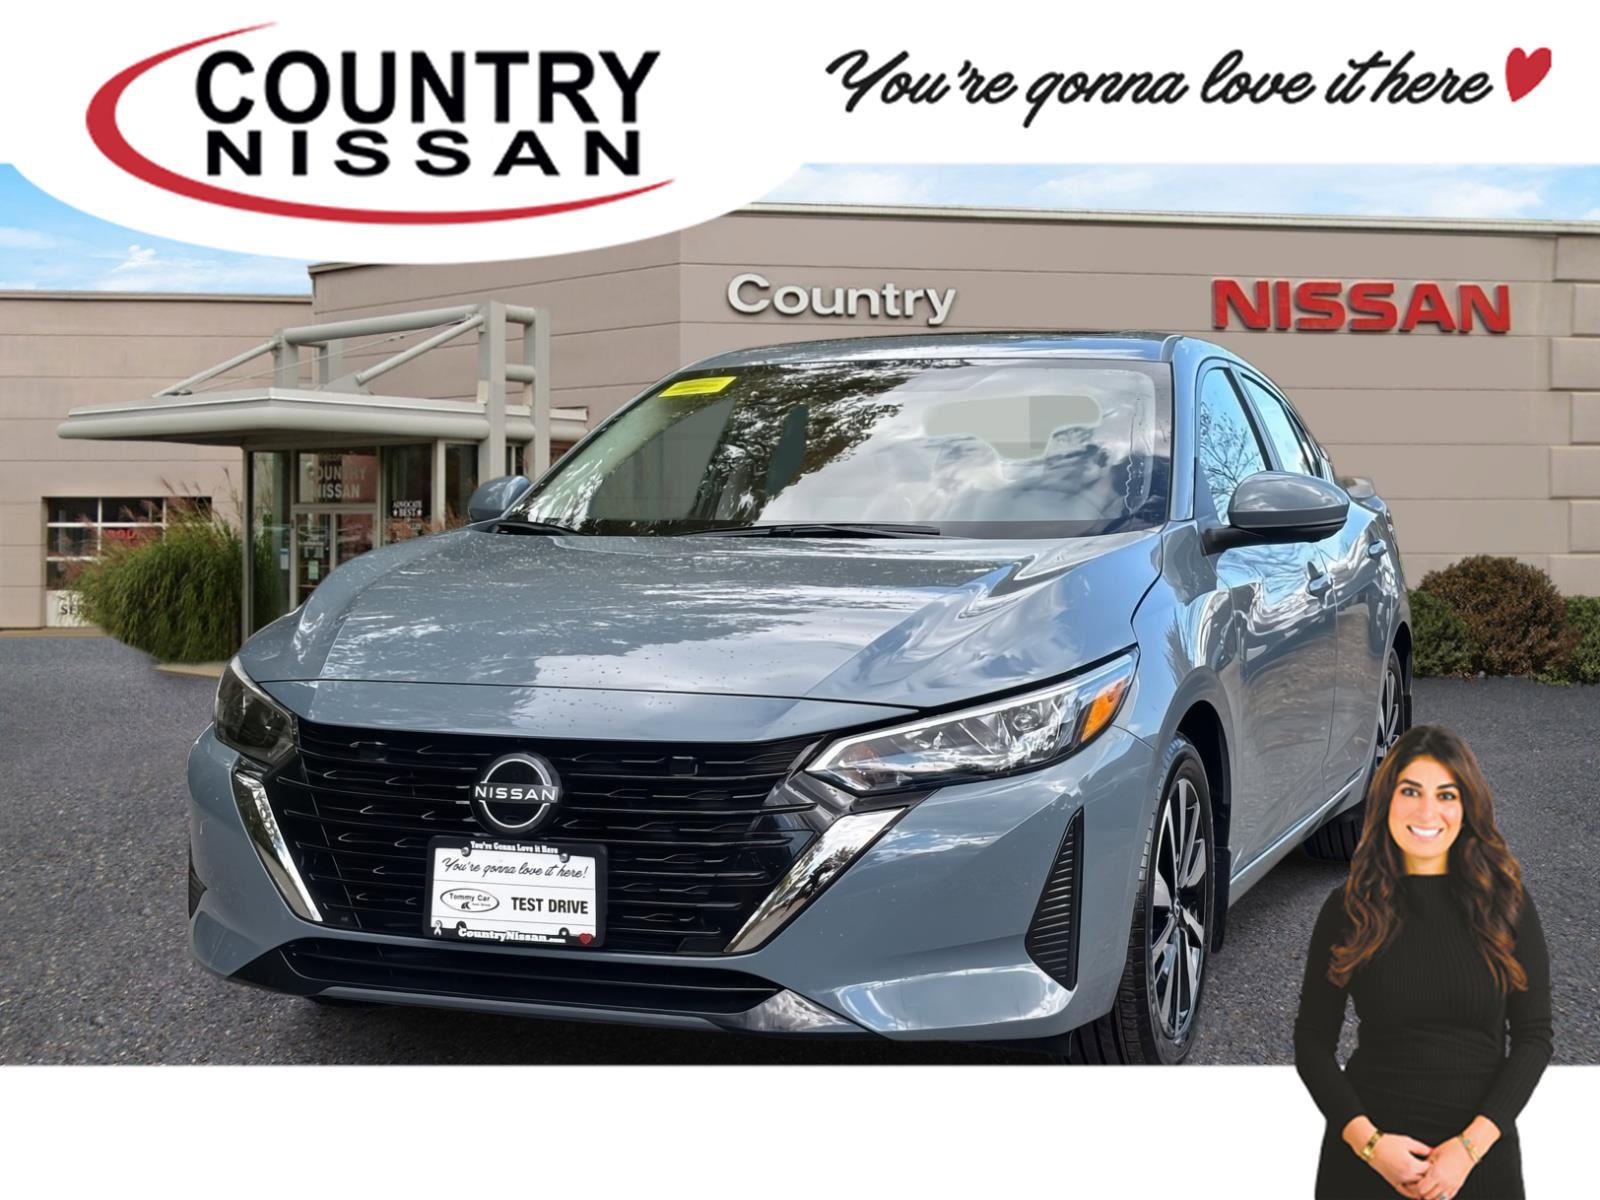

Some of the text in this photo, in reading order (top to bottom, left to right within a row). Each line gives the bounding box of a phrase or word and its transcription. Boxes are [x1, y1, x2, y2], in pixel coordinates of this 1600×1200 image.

[727, 272, 957, 326] Country
[1211, 278, 1511, 334] NISSAN
[474, 785, 557, 801] NISSAN
[516, 843, 534, 852] Love
[441, 857, 589, 880] You're gonna love it here!
[449, 893, 491, 902] Tommy Car
[511, 897, 589, 915] TEST DRIVE
[458, 926, 567, 943] CountryNissan.
